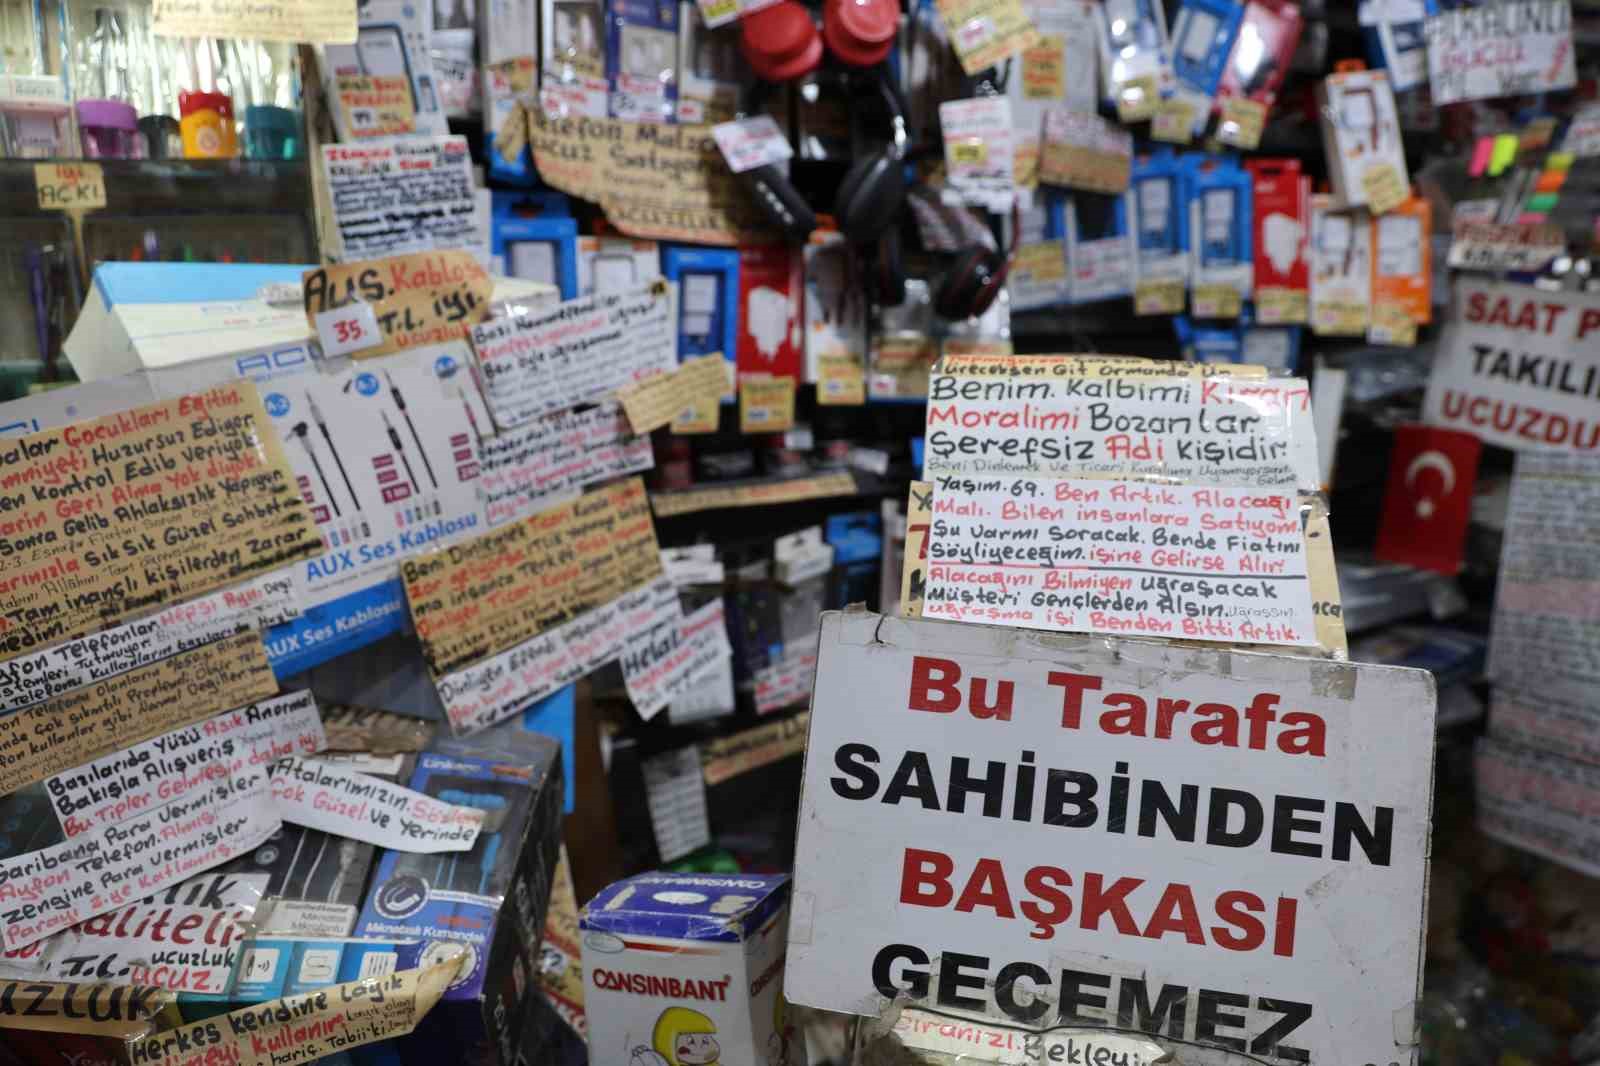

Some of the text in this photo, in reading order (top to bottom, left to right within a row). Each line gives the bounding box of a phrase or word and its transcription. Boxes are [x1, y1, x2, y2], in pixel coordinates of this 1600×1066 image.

[1463, 292, 1565, 336] SAAT
[931, 376, 1056, 401] Benim.
[1066, 377, 1191, 405] Kalbimi
[63, 407, 169, 448] Çocukları
[928, 403, 1080, 431] Moralimi
[92, 430, 184, 466] Huzursuz
[930, 431, 1094, 465] Şerefsiz
[1105, 434, 1165, 461] Adi
[125, 453, 176, 482] Edib
[56, 492, 103, 519] Geri
[166, 466, 201, 491] Yok
[1055, 482, 1101, 503] Ben
[1193, 489, 1291, 520] Alacağı
[63, 512, 109, 537] Gelib
[1001, 500, 1064, 521] Bilen
[1076, 504, 1189, 527] insanlara
[84, 543, 119, 567] Sık
[123, 533, 156, 557] Sık
[164, 518, 217, 547] Güzel
[307, 512, 479, 581] AUX Ses Kablosu
[1152, 527, 1216, 552] Bende
[1225, 536, 1300, 554] Fiatını
[145, 548, 241, 586] kişilerden
[1088, 546, 1143, 566] işine
[1149, 550, 1226, 572] Gelirse
[929, 567, 1033, 593] Alacağını
[1041, 571, 1132, 597] Bilmiyen
[927, 587, 1022, 607] Müşteri
[1030, 591, 1149, 612] Gençlerden
[1046, 608, 1074, 626] işi
[1087, 611, 1173, 633] Benden
[1183, 617, 1233, 637] Bitti
[264, 637, 302, 658] AUX
[302, 625, 335, 647] Ses
[907, 654, 1015, 729] Bu
[1047, 670, 1327, 757] Tarafa
[154, 726, 202, 755] Yüzü
[57, 773, 141, 818] Bakışla
[142, 739, 236, 784] Alışveriş
[64, 815, 94, 841] Bu
[95, 792, 152, 821] Tipler
[830, 743, 1394, 867] SAHİBİNDEN
[103, 822, 152, 846] Para
[399, 817, 475, 842] Yerinde
[101, 864, 143, 889] Para
[899, 846, 1298, 957] BAŞKASI
[592, 967, 726, 1002] CANSINBANT
[227, 989, 329, 1038] kendine
